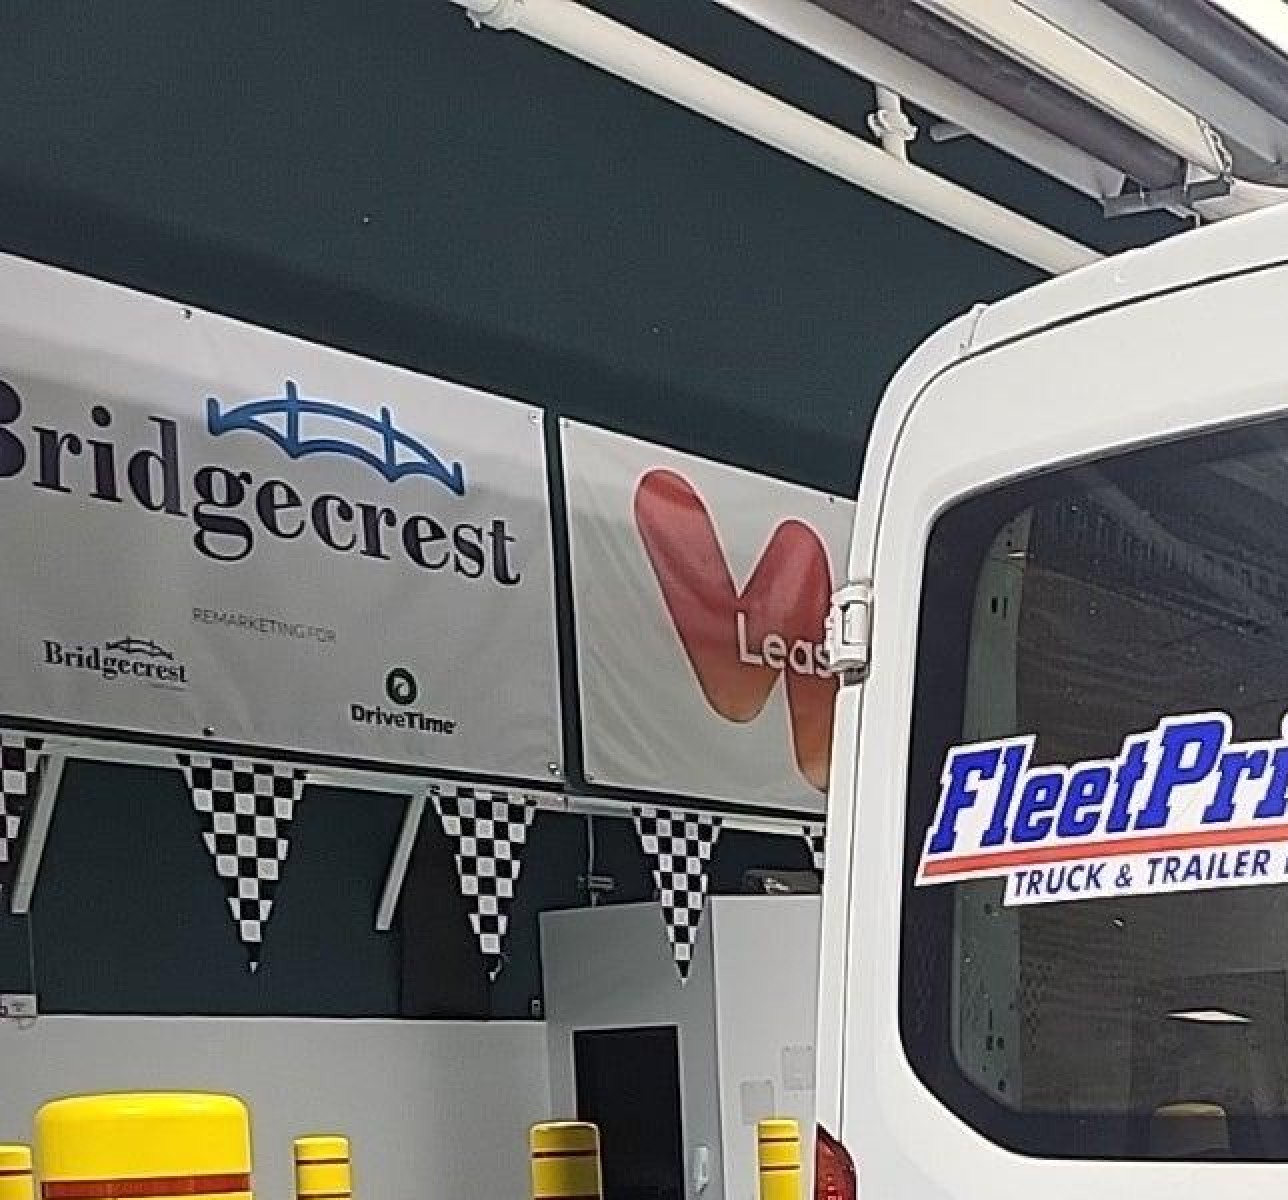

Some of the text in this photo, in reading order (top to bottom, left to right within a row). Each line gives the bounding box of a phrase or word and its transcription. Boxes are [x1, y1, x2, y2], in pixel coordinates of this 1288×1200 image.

[193, 607, 305, 639] REMARKETING
[736, 611, 834, 677] Leas
[42, 639, 188, 683] Bridgecrest
[351, 703, 456, 735] DriveTime
[1013, 862, 1102, 898] TRUCK
[1115, 861, 1133, 887] &
[1146, 848, 1269, 885] TRAILER
